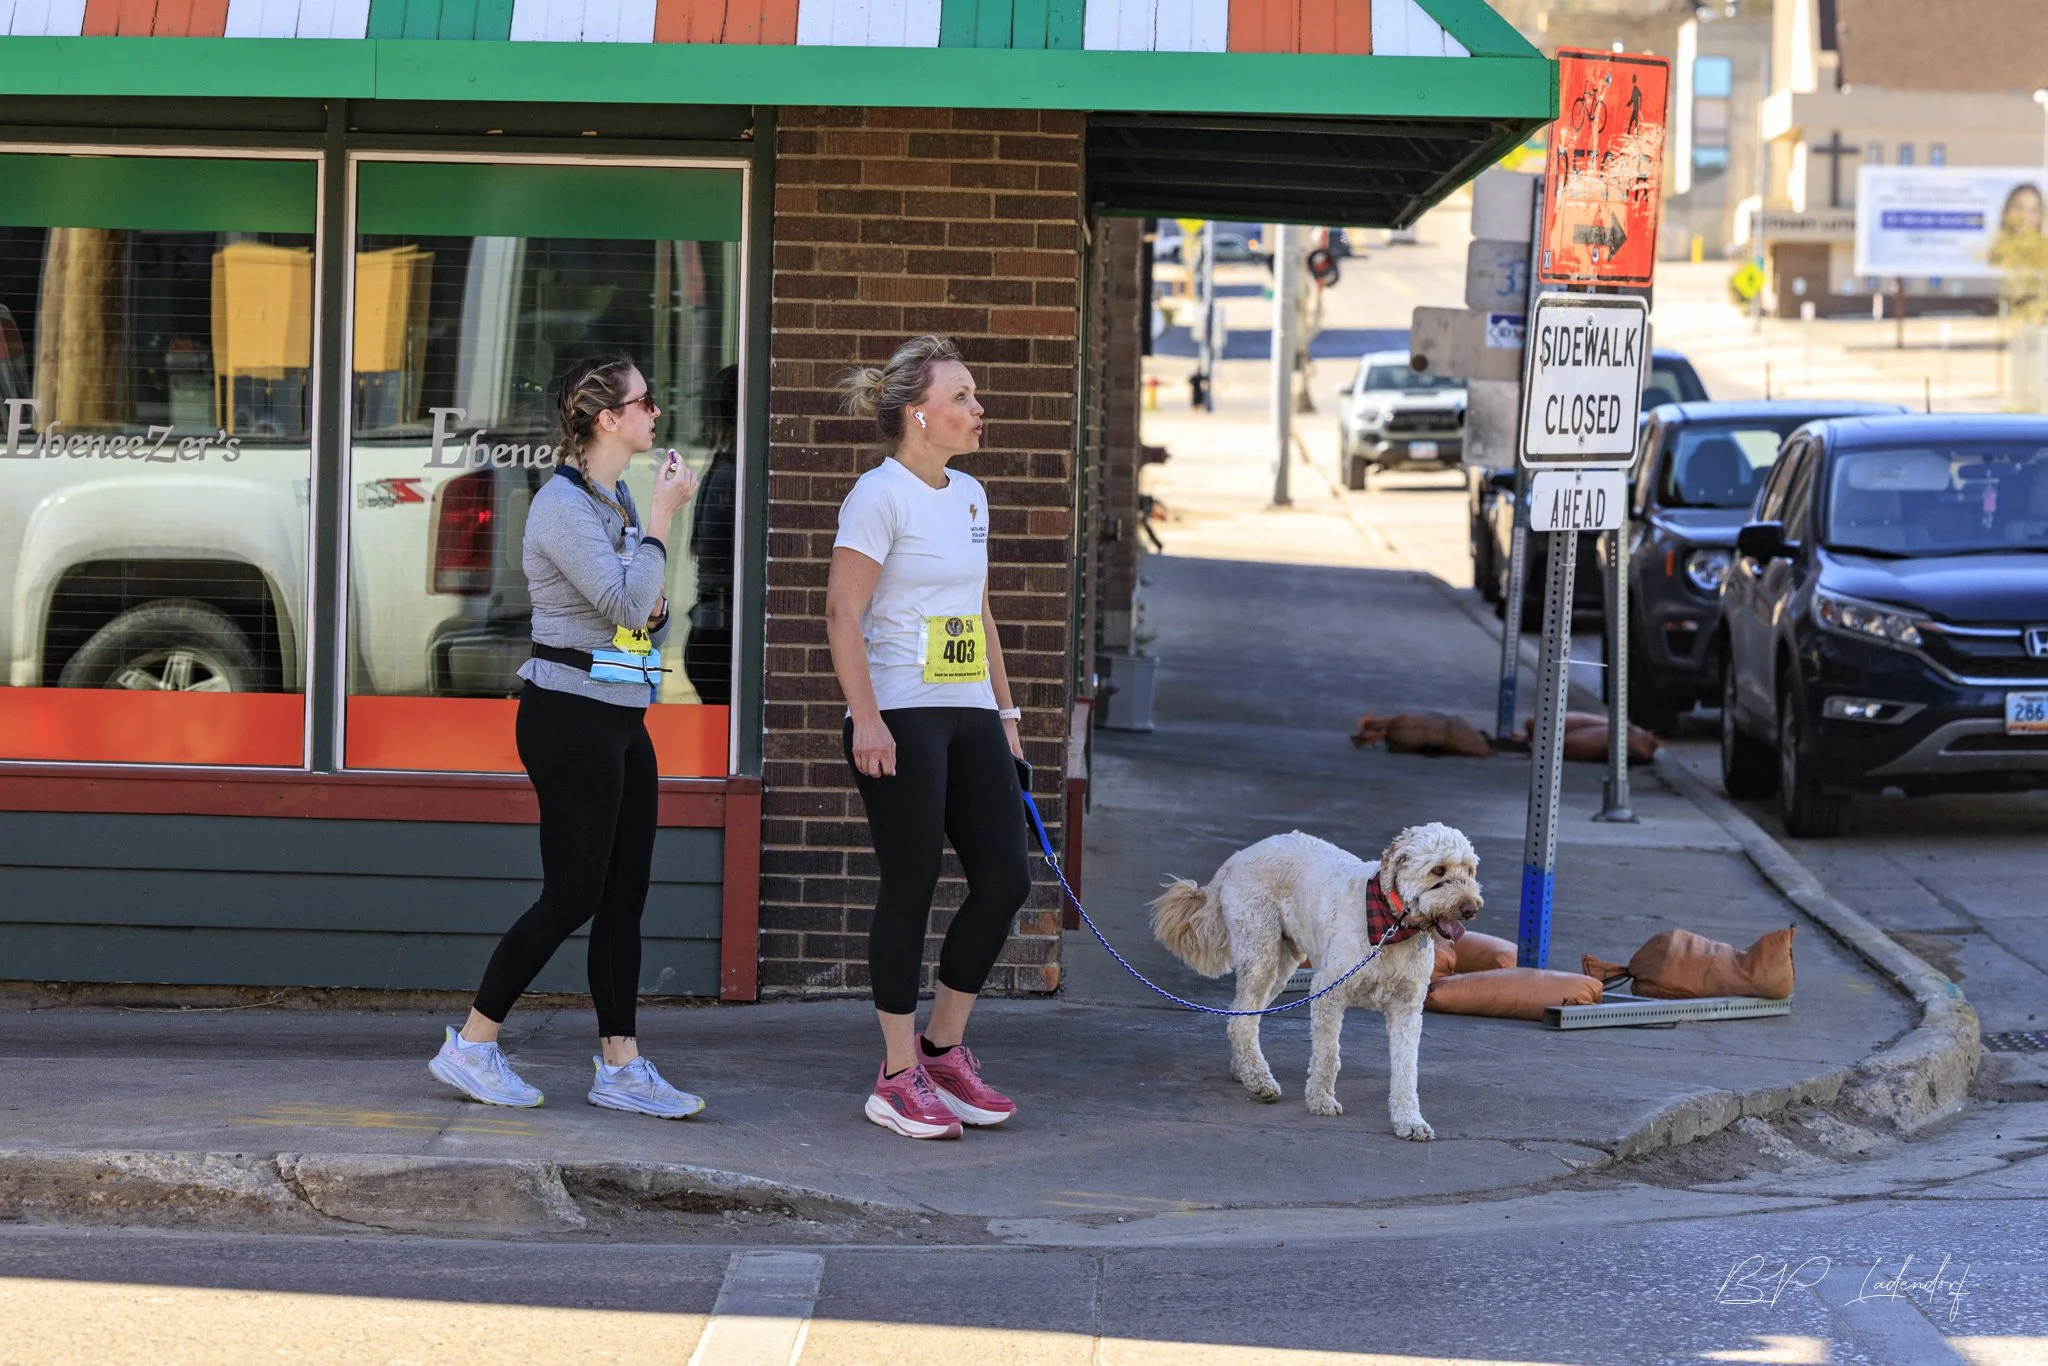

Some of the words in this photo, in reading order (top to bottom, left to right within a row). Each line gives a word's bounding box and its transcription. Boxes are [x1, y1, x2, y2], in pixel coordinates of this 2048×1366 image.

[1540, 325, 1637, 369] SIDEWALK
[1545, 394, 1621, 435] CLOSED
[1550, 488, 1606, 529] AHEAD
[965, 619, 975, 633] 5K
[943, 639, 976, 664] 403
